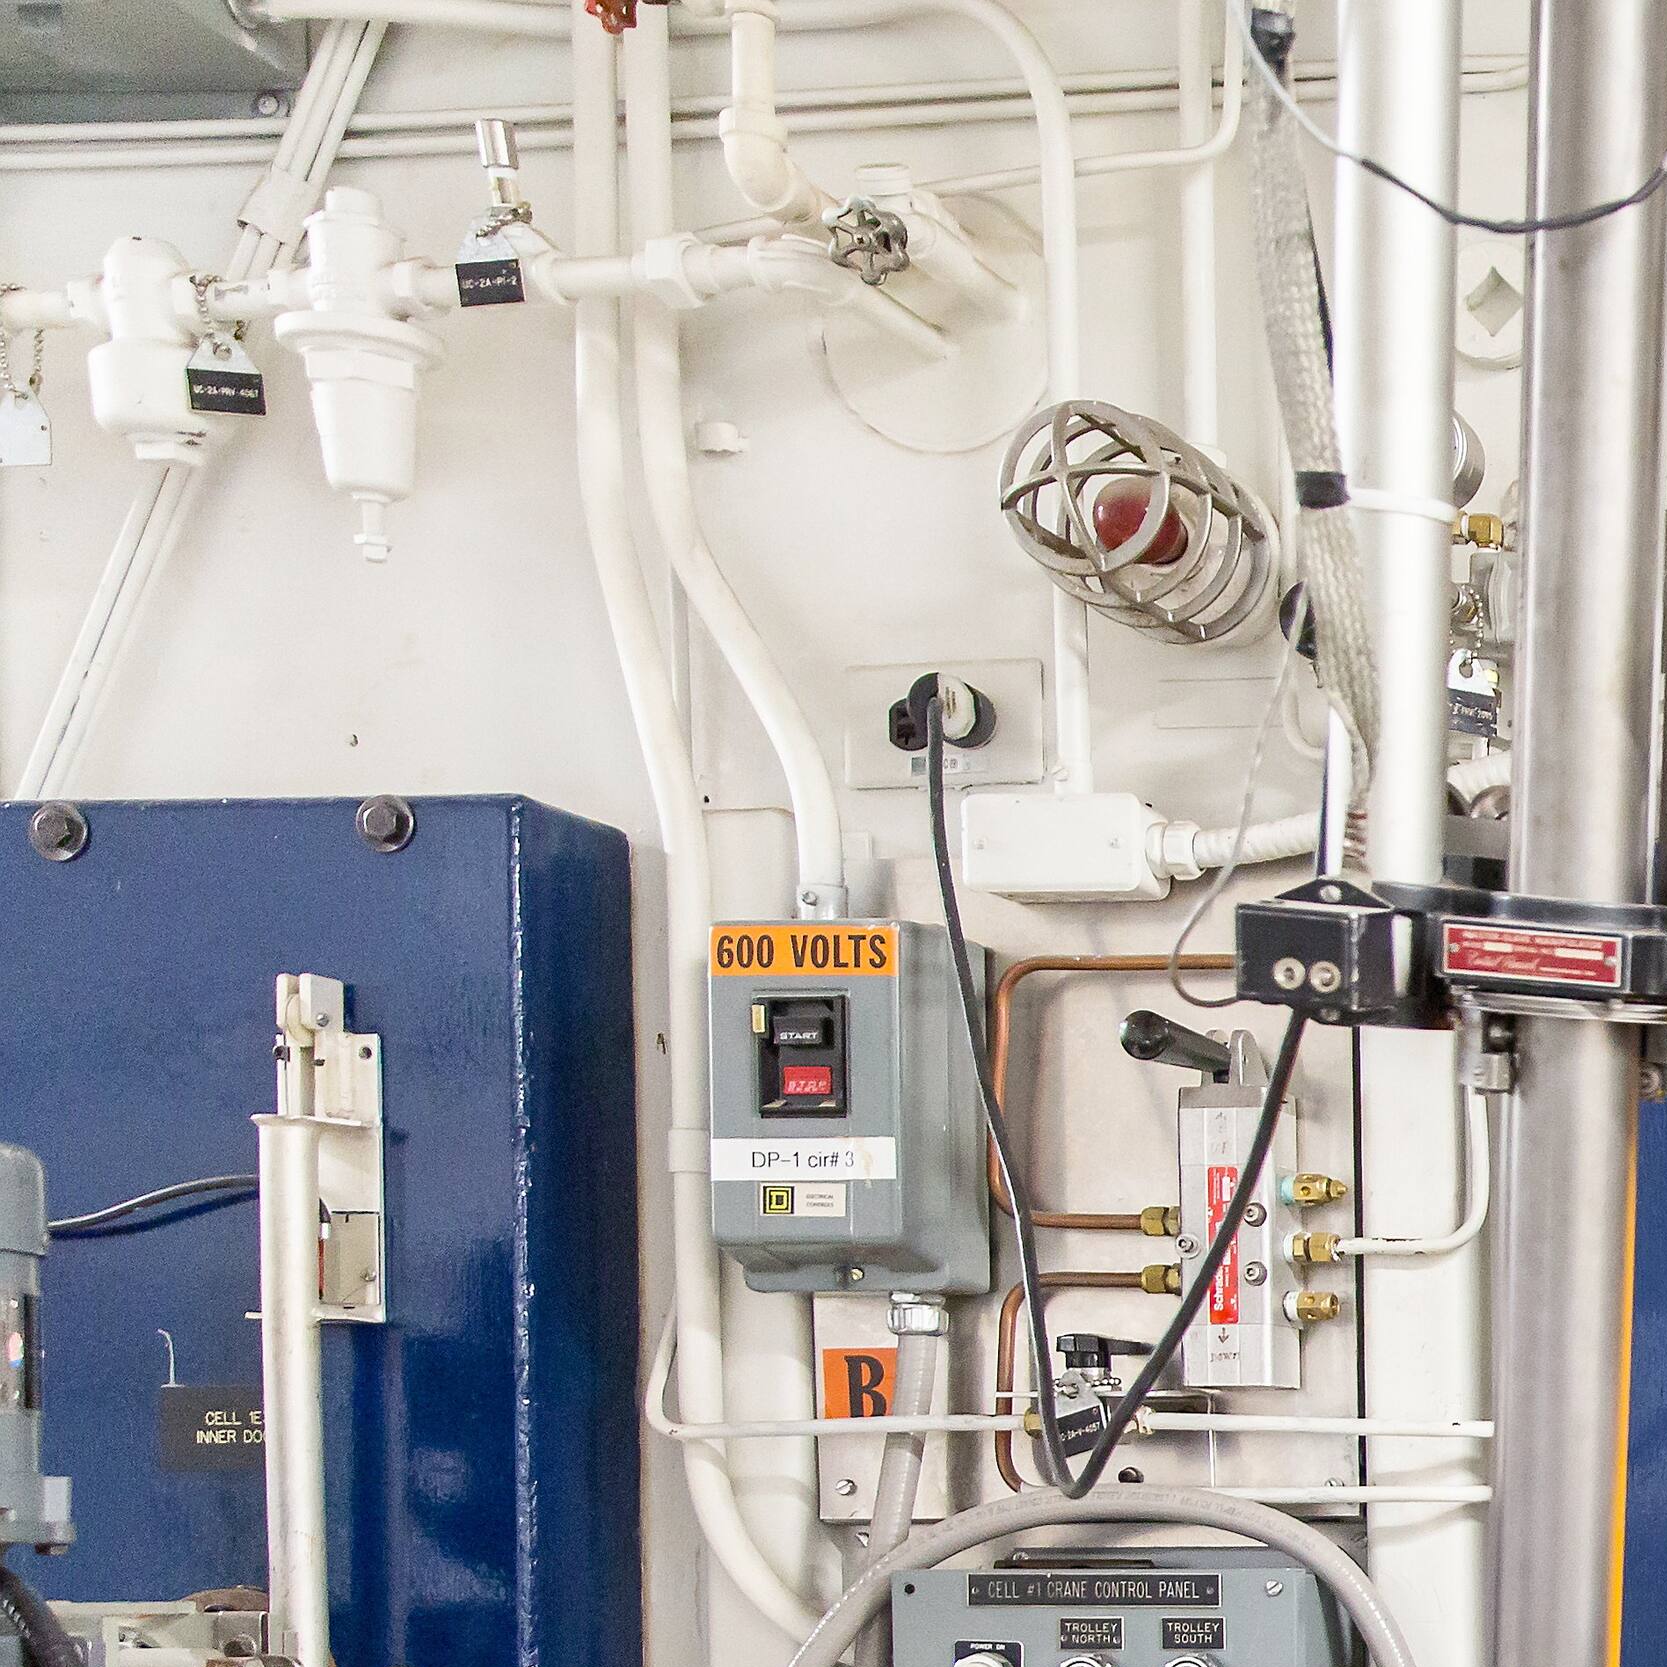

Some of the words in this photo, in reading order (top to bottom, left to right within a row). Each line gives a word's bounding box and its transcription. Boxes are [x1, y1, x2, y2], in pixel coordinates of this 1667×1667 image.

[717, 934, 775, 969] 600
[790, 934, 887, 969] VOLTS
[779, 1031, 818, 1040] START
[788, 1079, 828, 1092] STOP
[752, 1151, 800, 1168] DP-1
[808, 1150, 839, 1168] cir#
[845, 1151, 855, 1168] 3
[205, 1411, 242, 1425] CELL
[196, 1429, 237, 1443] INNER
[243, 1429, 265, 1443] DO
[987, 1581, 1020, 1599] CELL
[1026, 1582, 1042, 1598] #1
[1047, 1580, 1087, 1599] CRANE
[1094, 1580, 1152, 1599] CONTROL
[1159, 1580, 1200, 1599] PANEL
[1065, 1622, 1118, 1633] TROLLEY
[1167, 1622, 1220, 1633] TROLLEY
[1072, 1634, 1110, 1644] NORTH
[1174, 1634, 1213, 1644] SOUTH
